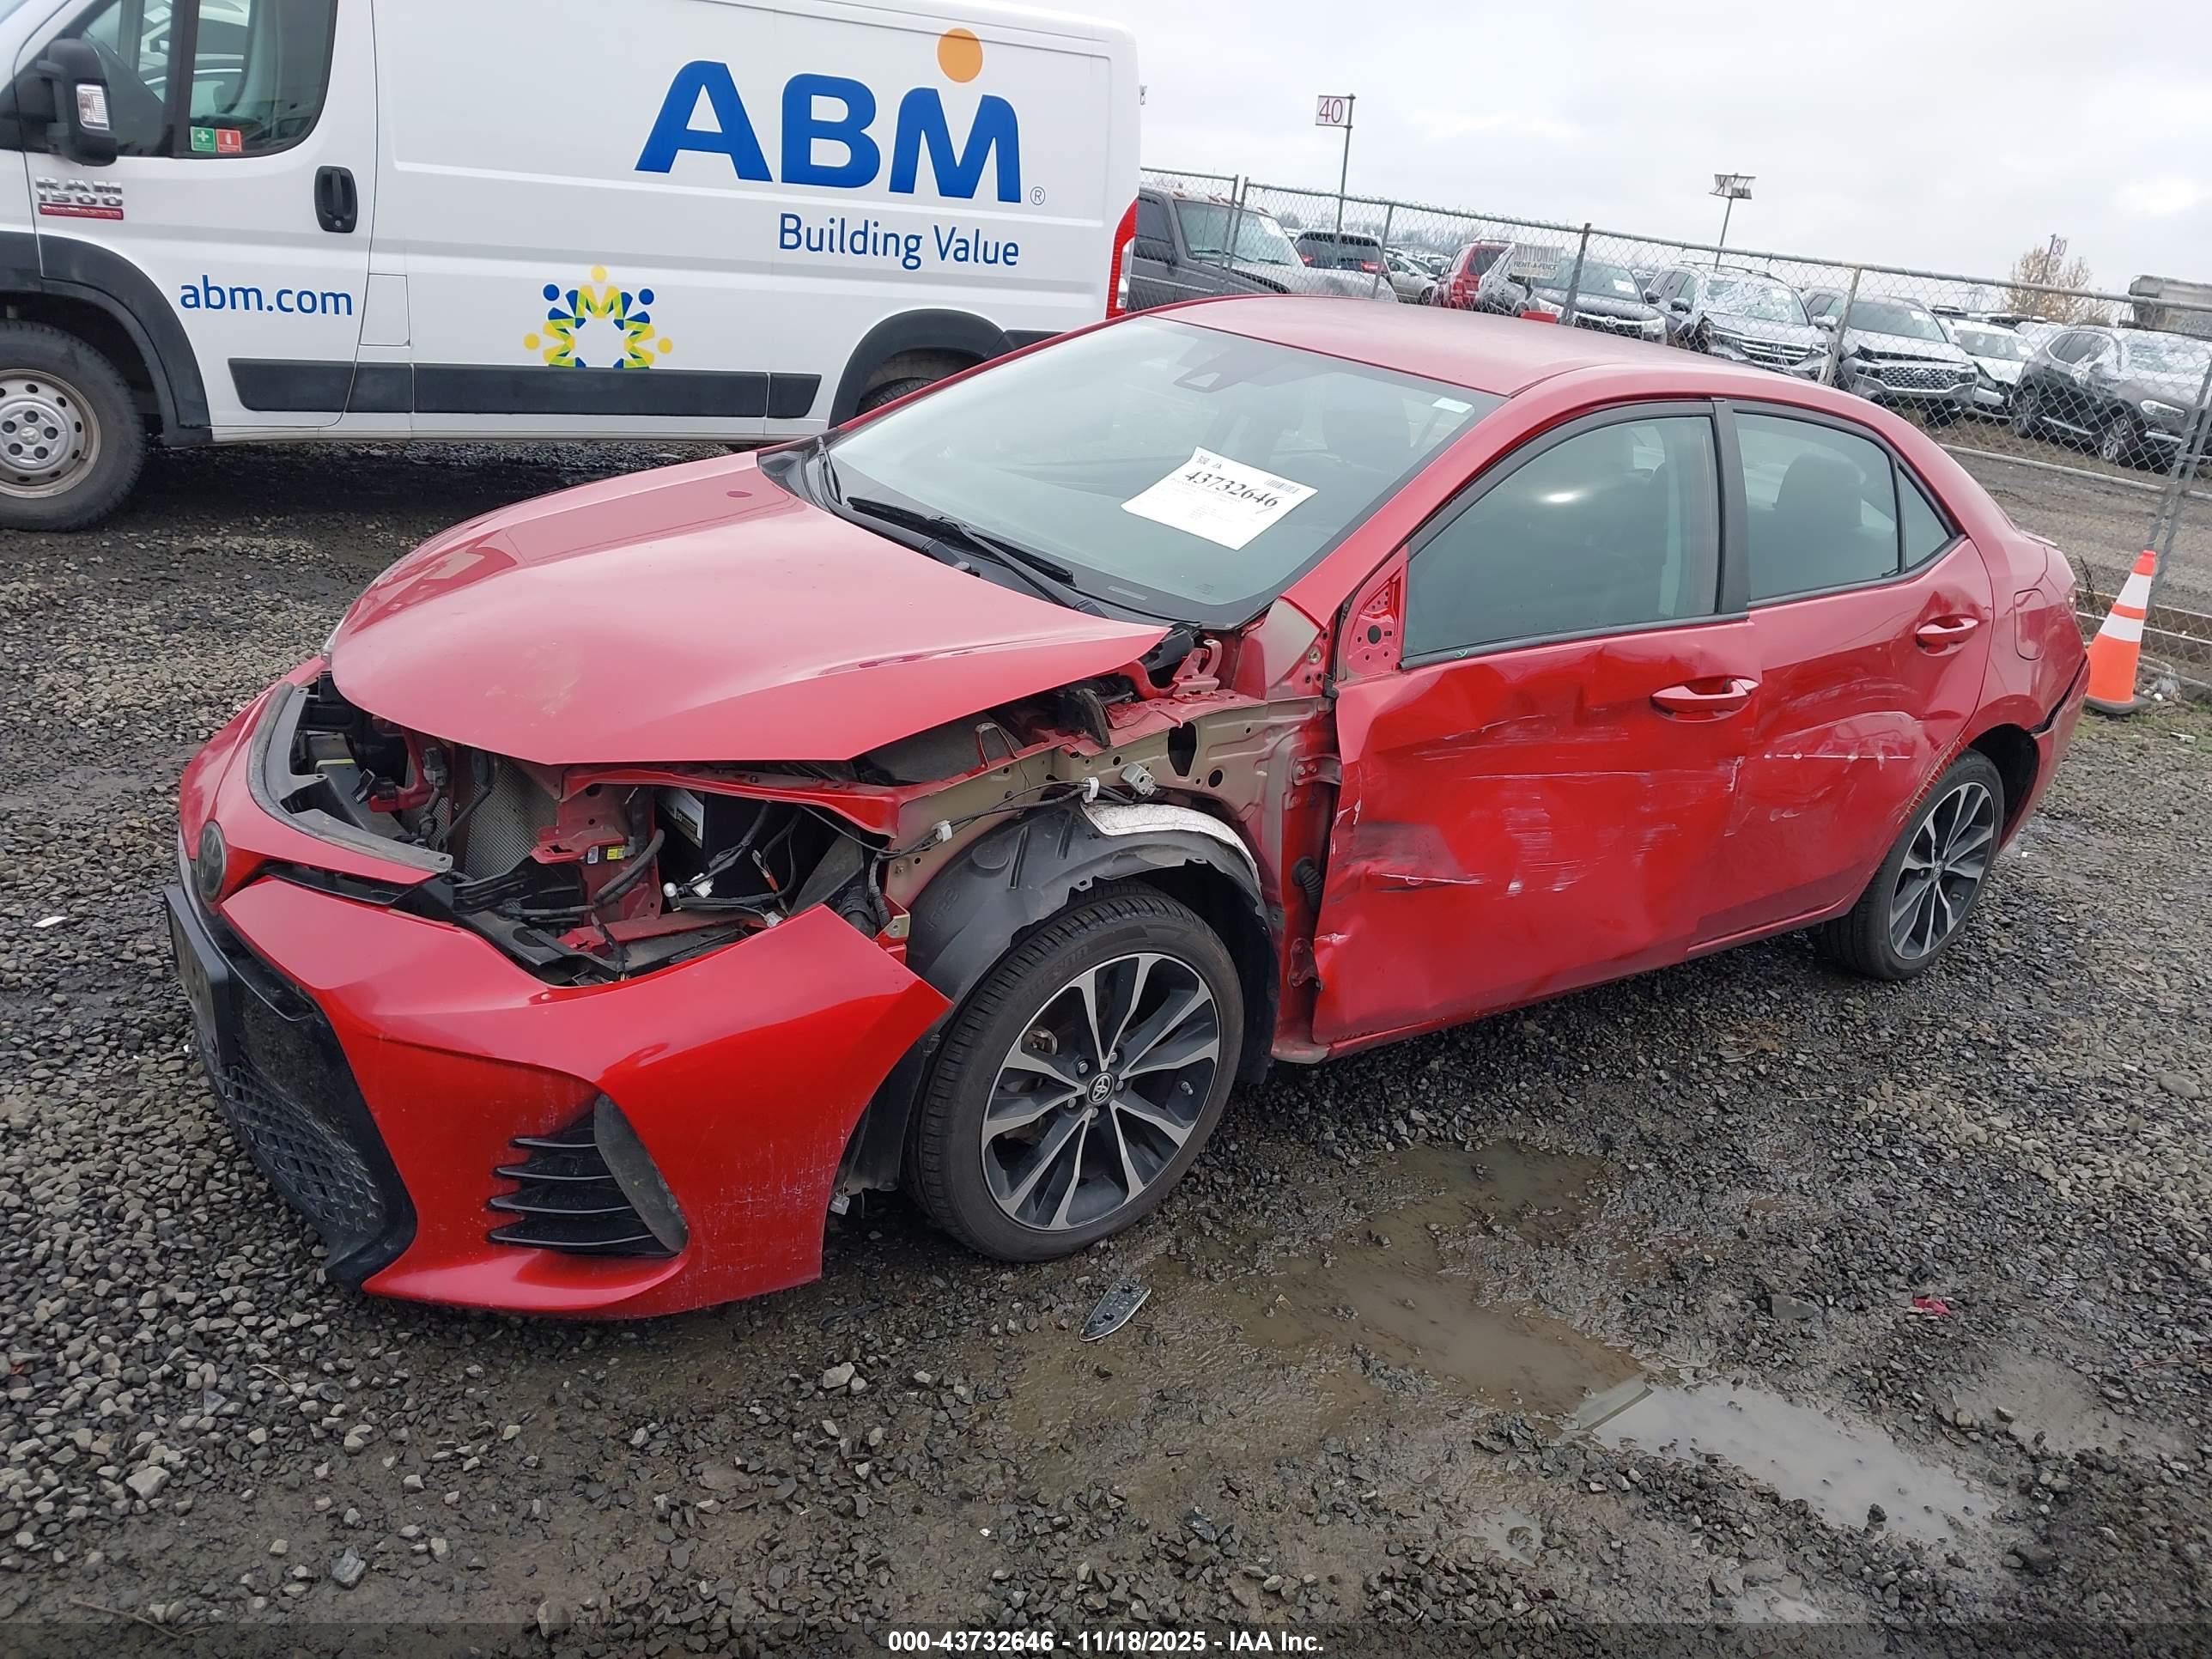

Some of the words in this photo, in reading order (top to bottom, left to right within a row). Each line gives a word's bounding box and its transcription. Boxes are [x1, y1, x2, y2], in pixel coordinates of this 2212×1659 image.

[1319, 97, 1343, 124] 40
[635, 59, 1022, 203] ABM
[35, 177, 122, 193] RAM
[37, 189, 123, 206] 1500
[779, 212, 923, 270] Building
[933, 224, 1019, 265] Value
[180, 274, 353, 315] abm.com
[1185, 471, 1285, 507] 43732646
